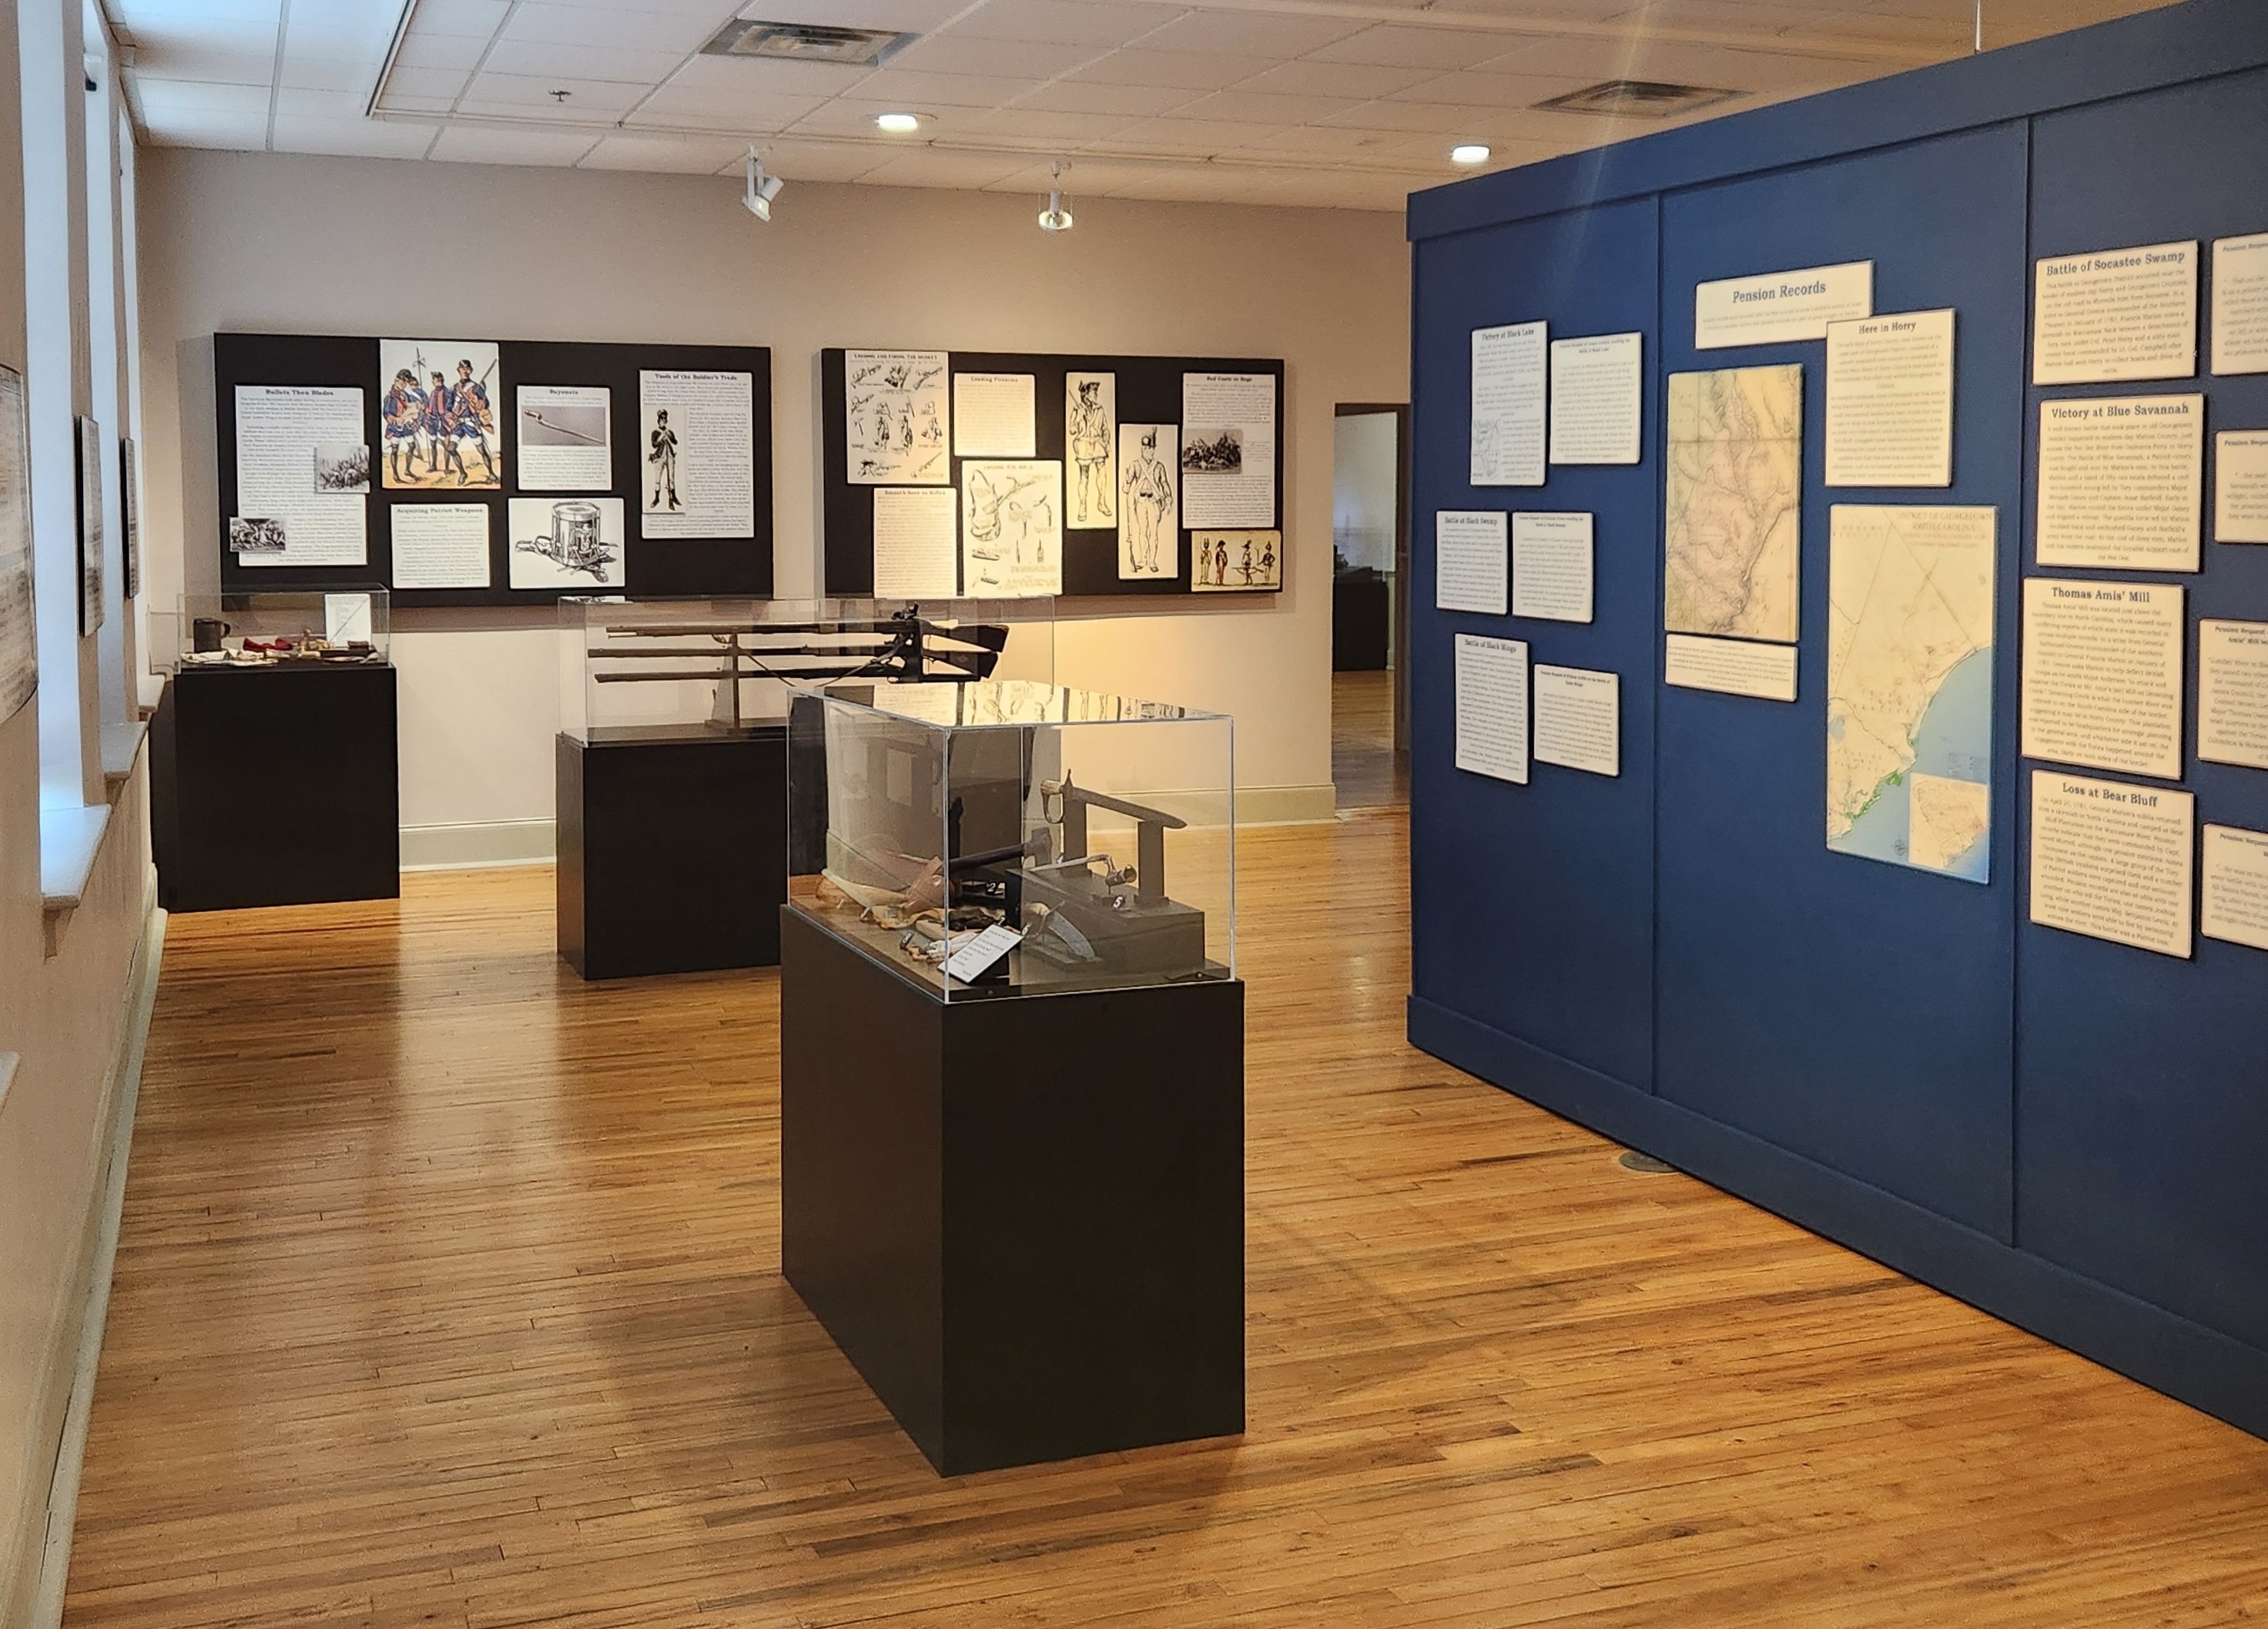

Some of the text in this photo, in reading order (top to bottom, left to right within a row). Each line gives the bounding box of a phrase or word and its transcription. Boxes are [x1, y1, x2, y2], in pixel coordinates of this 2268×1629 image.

[2046, 252, 2185, 276] Battle of Socastee Swamp
[1733, 280, 1826, 303] Pension Records
[1859, 322, 1916, 334] Here in Horry
[2052, 402, 2189, 420] Victory at Blue Savannah
[2052, 588, 2150, 602] Thomas Amis' Mill
[2062, 783, 2158, 807] Loss at Bear Bluff
[988, 883, 996, 892] 2
[1113, 897, 1122, 909] 5
